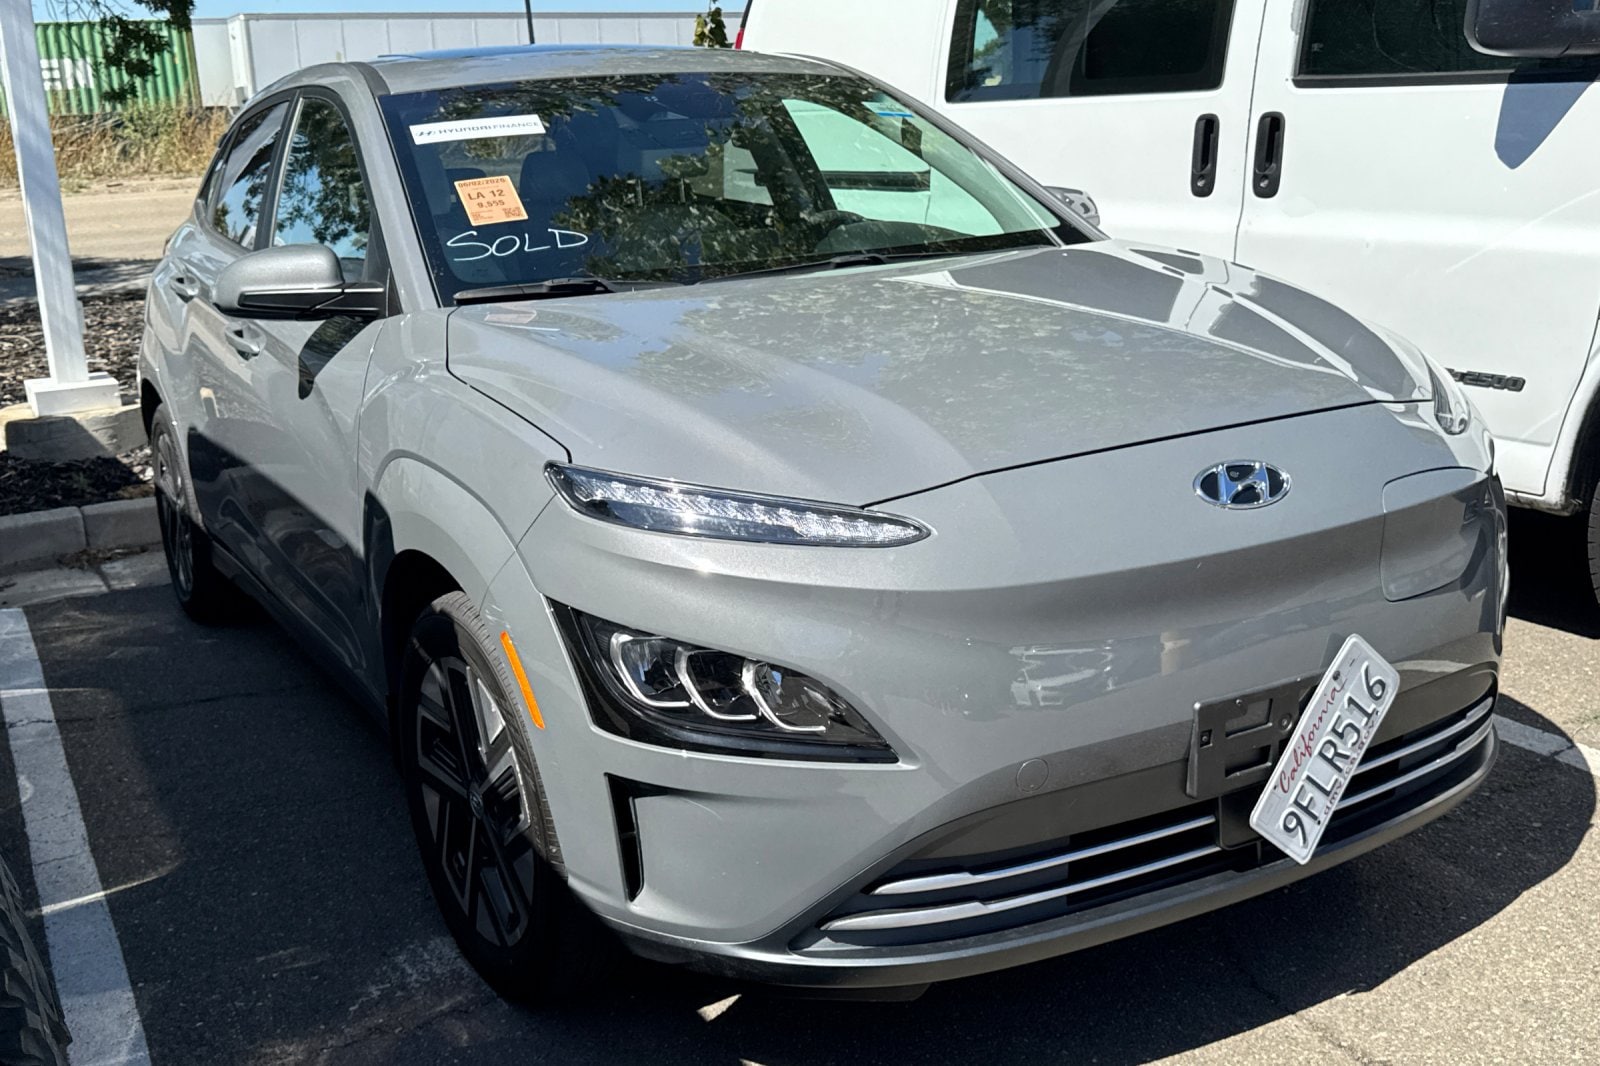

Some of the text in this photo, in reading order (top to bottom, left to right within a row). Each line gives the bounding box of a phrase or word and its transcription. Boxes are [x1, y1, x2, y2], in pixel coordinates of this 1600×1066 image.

[467, 189, 506, 201] LA 12
[446, 229, 589, 262] SOLD
[1279, 678, 1348, 794] California
[1281, 661, 1386, 848] 9FLR516
